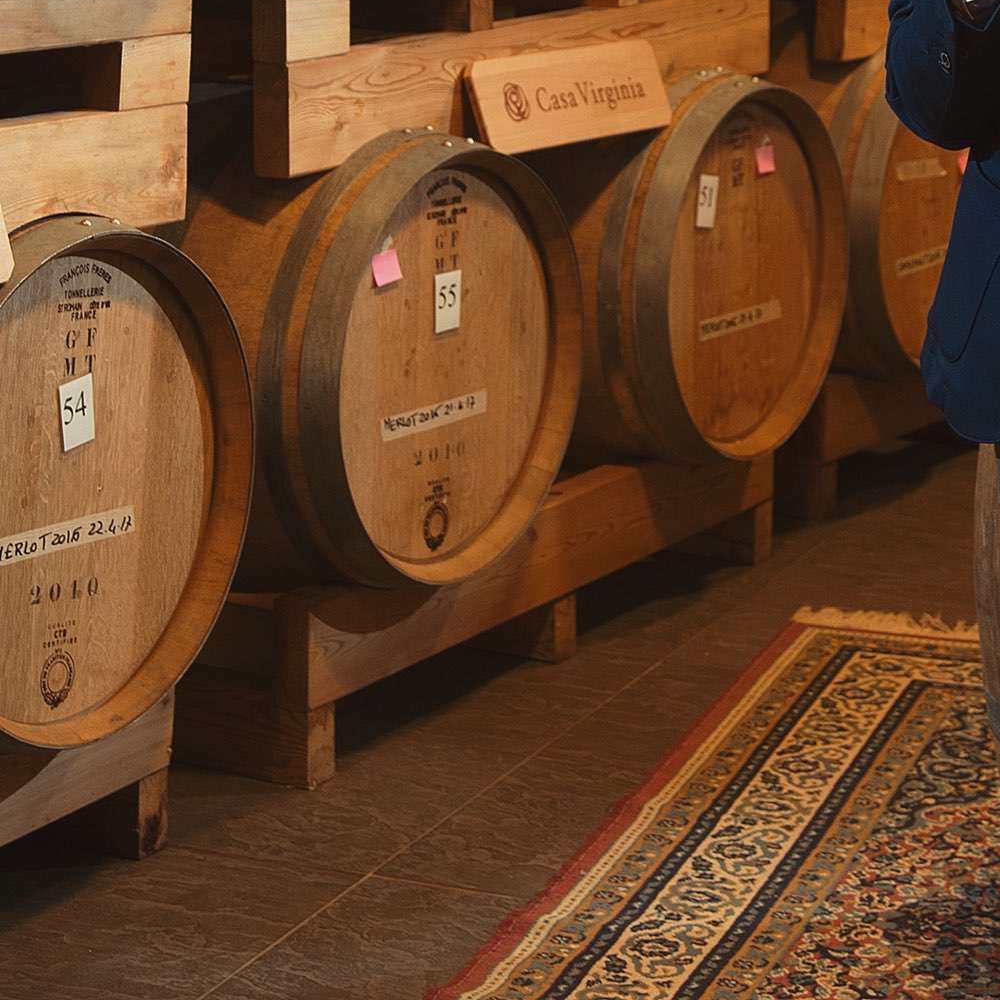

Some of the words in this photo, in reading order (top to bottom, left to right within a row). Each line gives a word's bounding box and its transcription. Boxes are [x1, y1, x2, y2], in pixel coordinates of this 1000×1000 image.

[535, 87, 576, 113] Casa
[574, 76, 646, 110] Virginia
[64, 286, 105, 300] TONNELLERIE
[438, 284, 457, 310] 55
[71, 310, 97, 321] FRANCE
[64, 391, 87, 425] 54
[51, 526, 83, 546] 2016
[88, 515, 132, 536] 22.4.17
[30, 576, 99, 605] 2010
